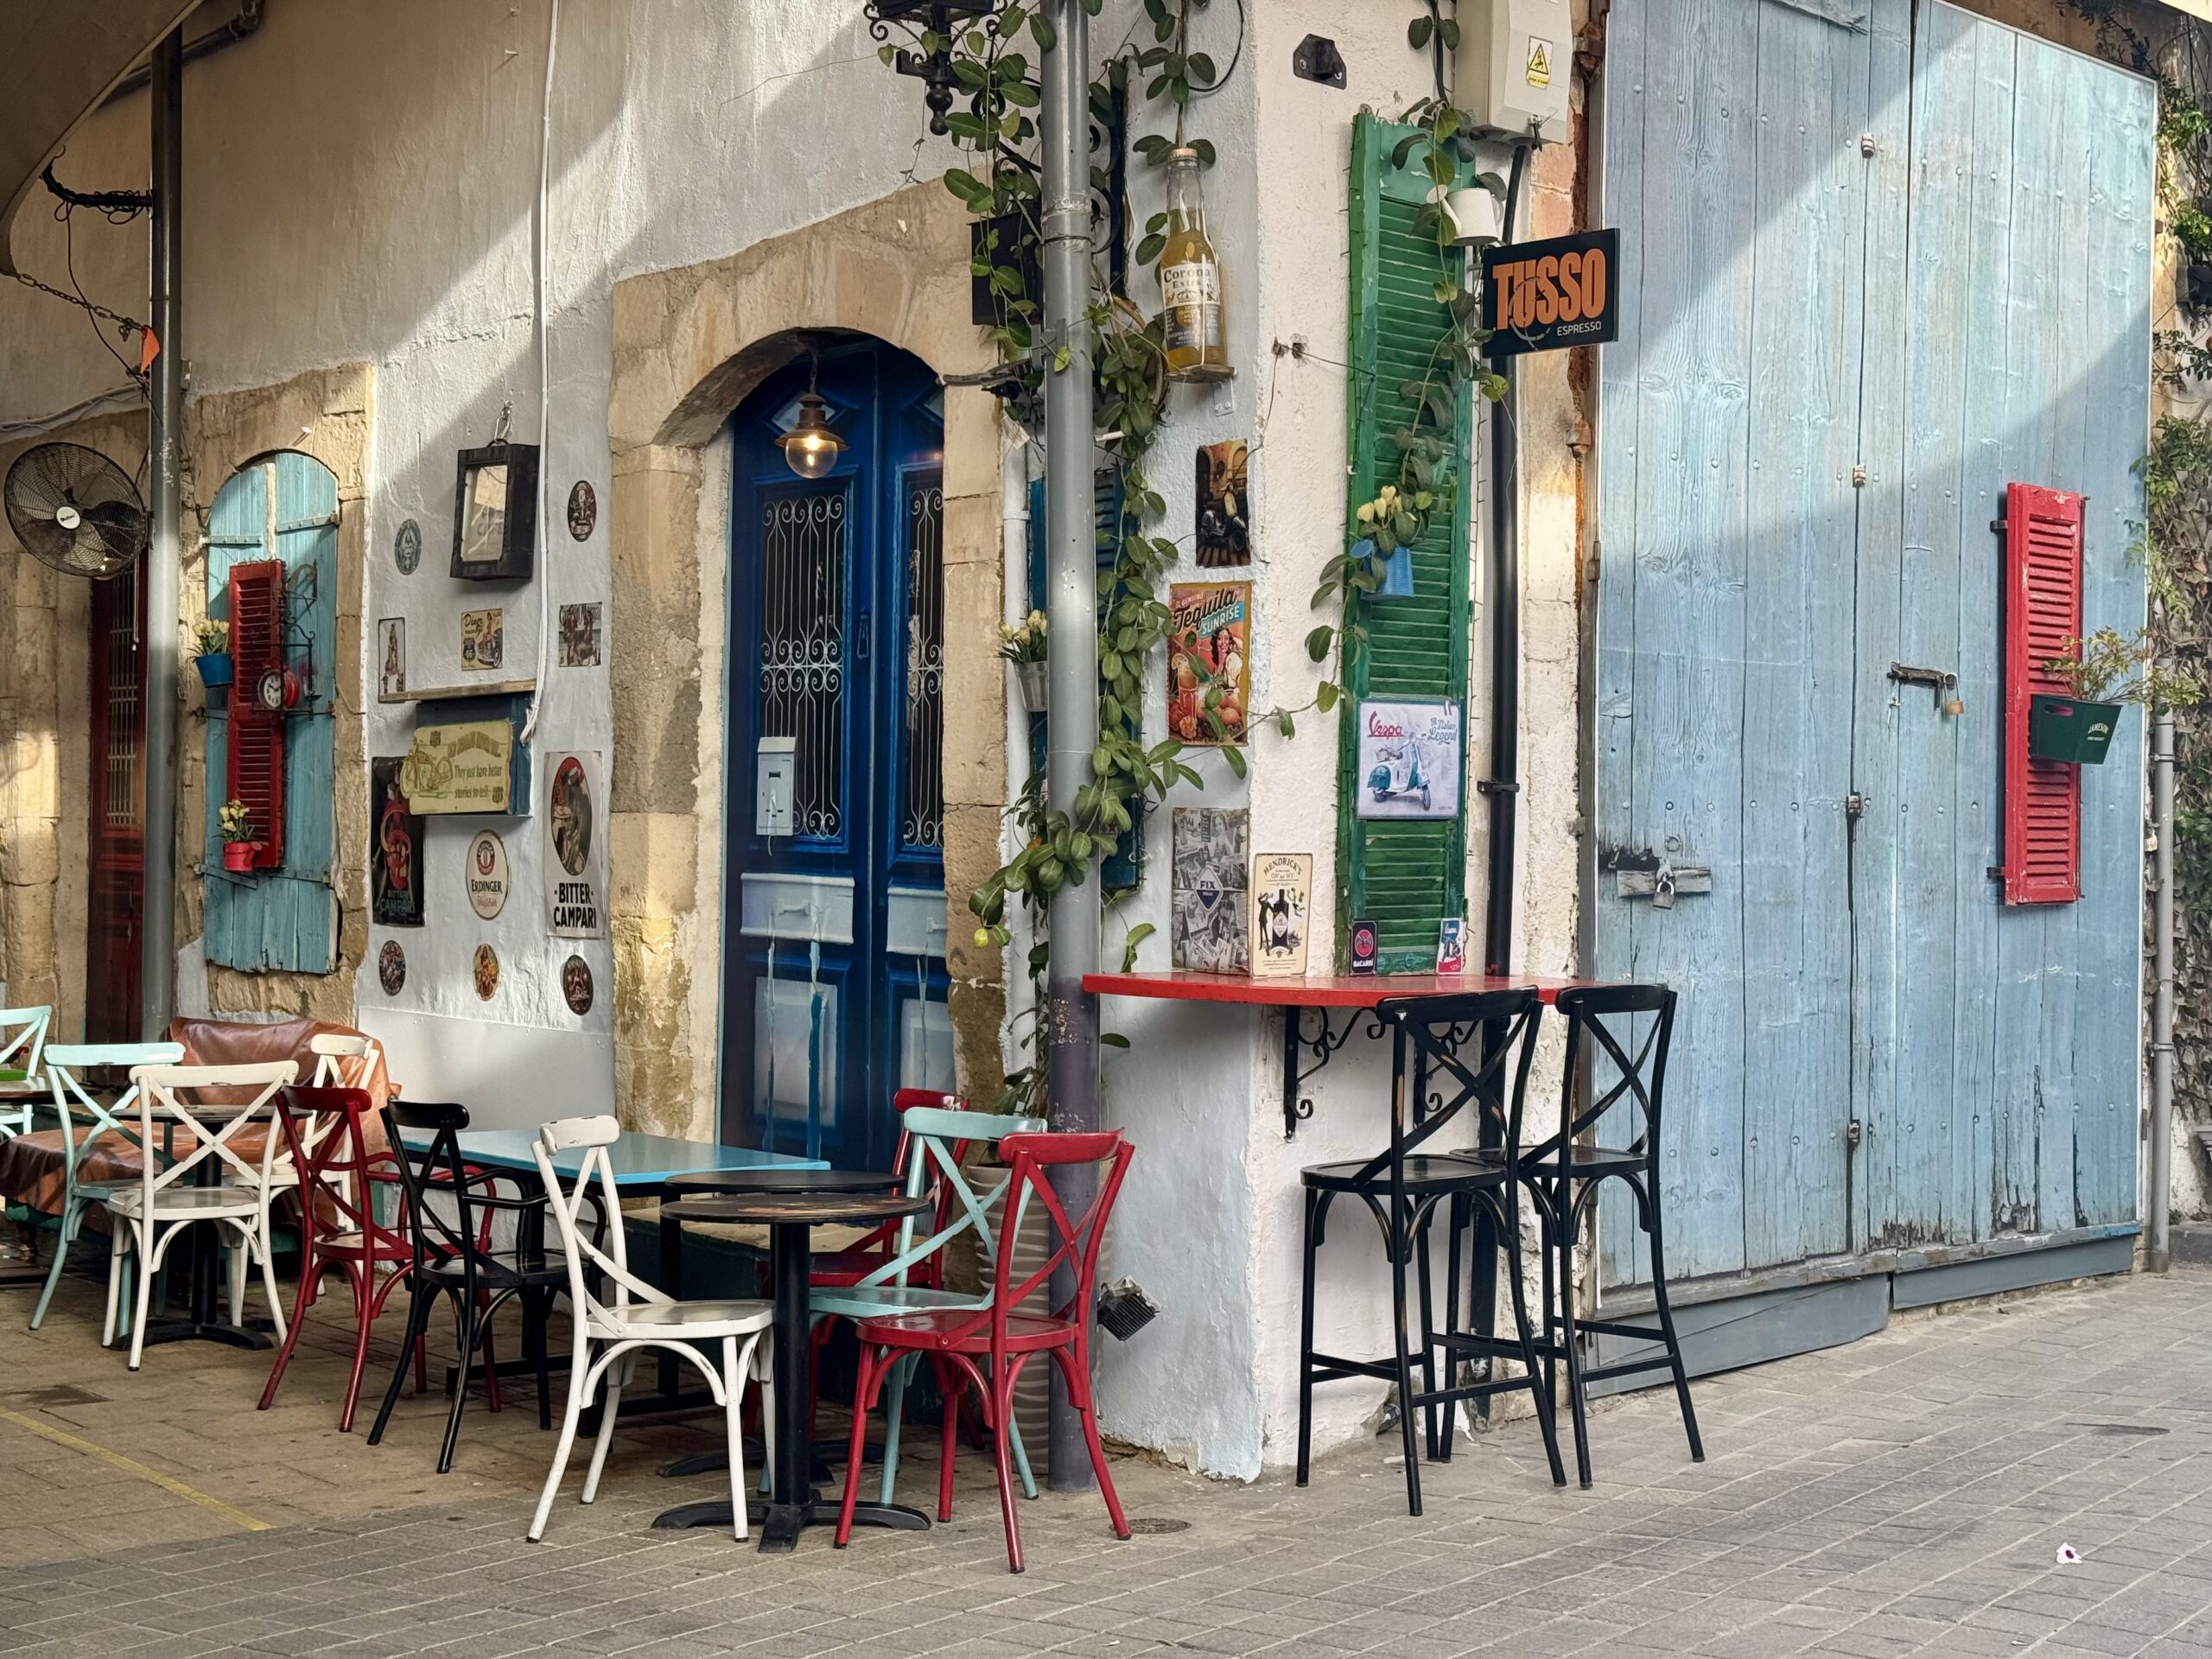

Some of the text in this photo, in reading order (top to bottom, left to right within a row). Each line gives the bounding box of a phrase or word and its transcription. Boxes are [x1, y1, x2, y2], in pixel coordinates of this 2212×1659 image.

[1164, 269, 1211, 283] Corona
[1173, 280, 1202, 289] Extra
[1492, 248, 1606, 331] TUSSO
[1557, 321, 1602, 337] ESPRESSO
[1174, 588, 1237, 634] Tequila
[1202, 605, 1240, 635] SUNRISE
[1367, 710, 1405, 740] Vespa
[2088, 722, 2109, 734] JAMESON
[1427, 727, 1458, 745] Legend
[454, 765, 466, 780] They
[476, 764, 487, 779] have
[471, 879, 503, 894] ERDINGER
[1200, 880, 1216, 889] FIX
[558, 882, 592, 904] BITTER
[379, 899, 416, 913] CAMPARI
[554, 906, 597, 929] CAMPARI
